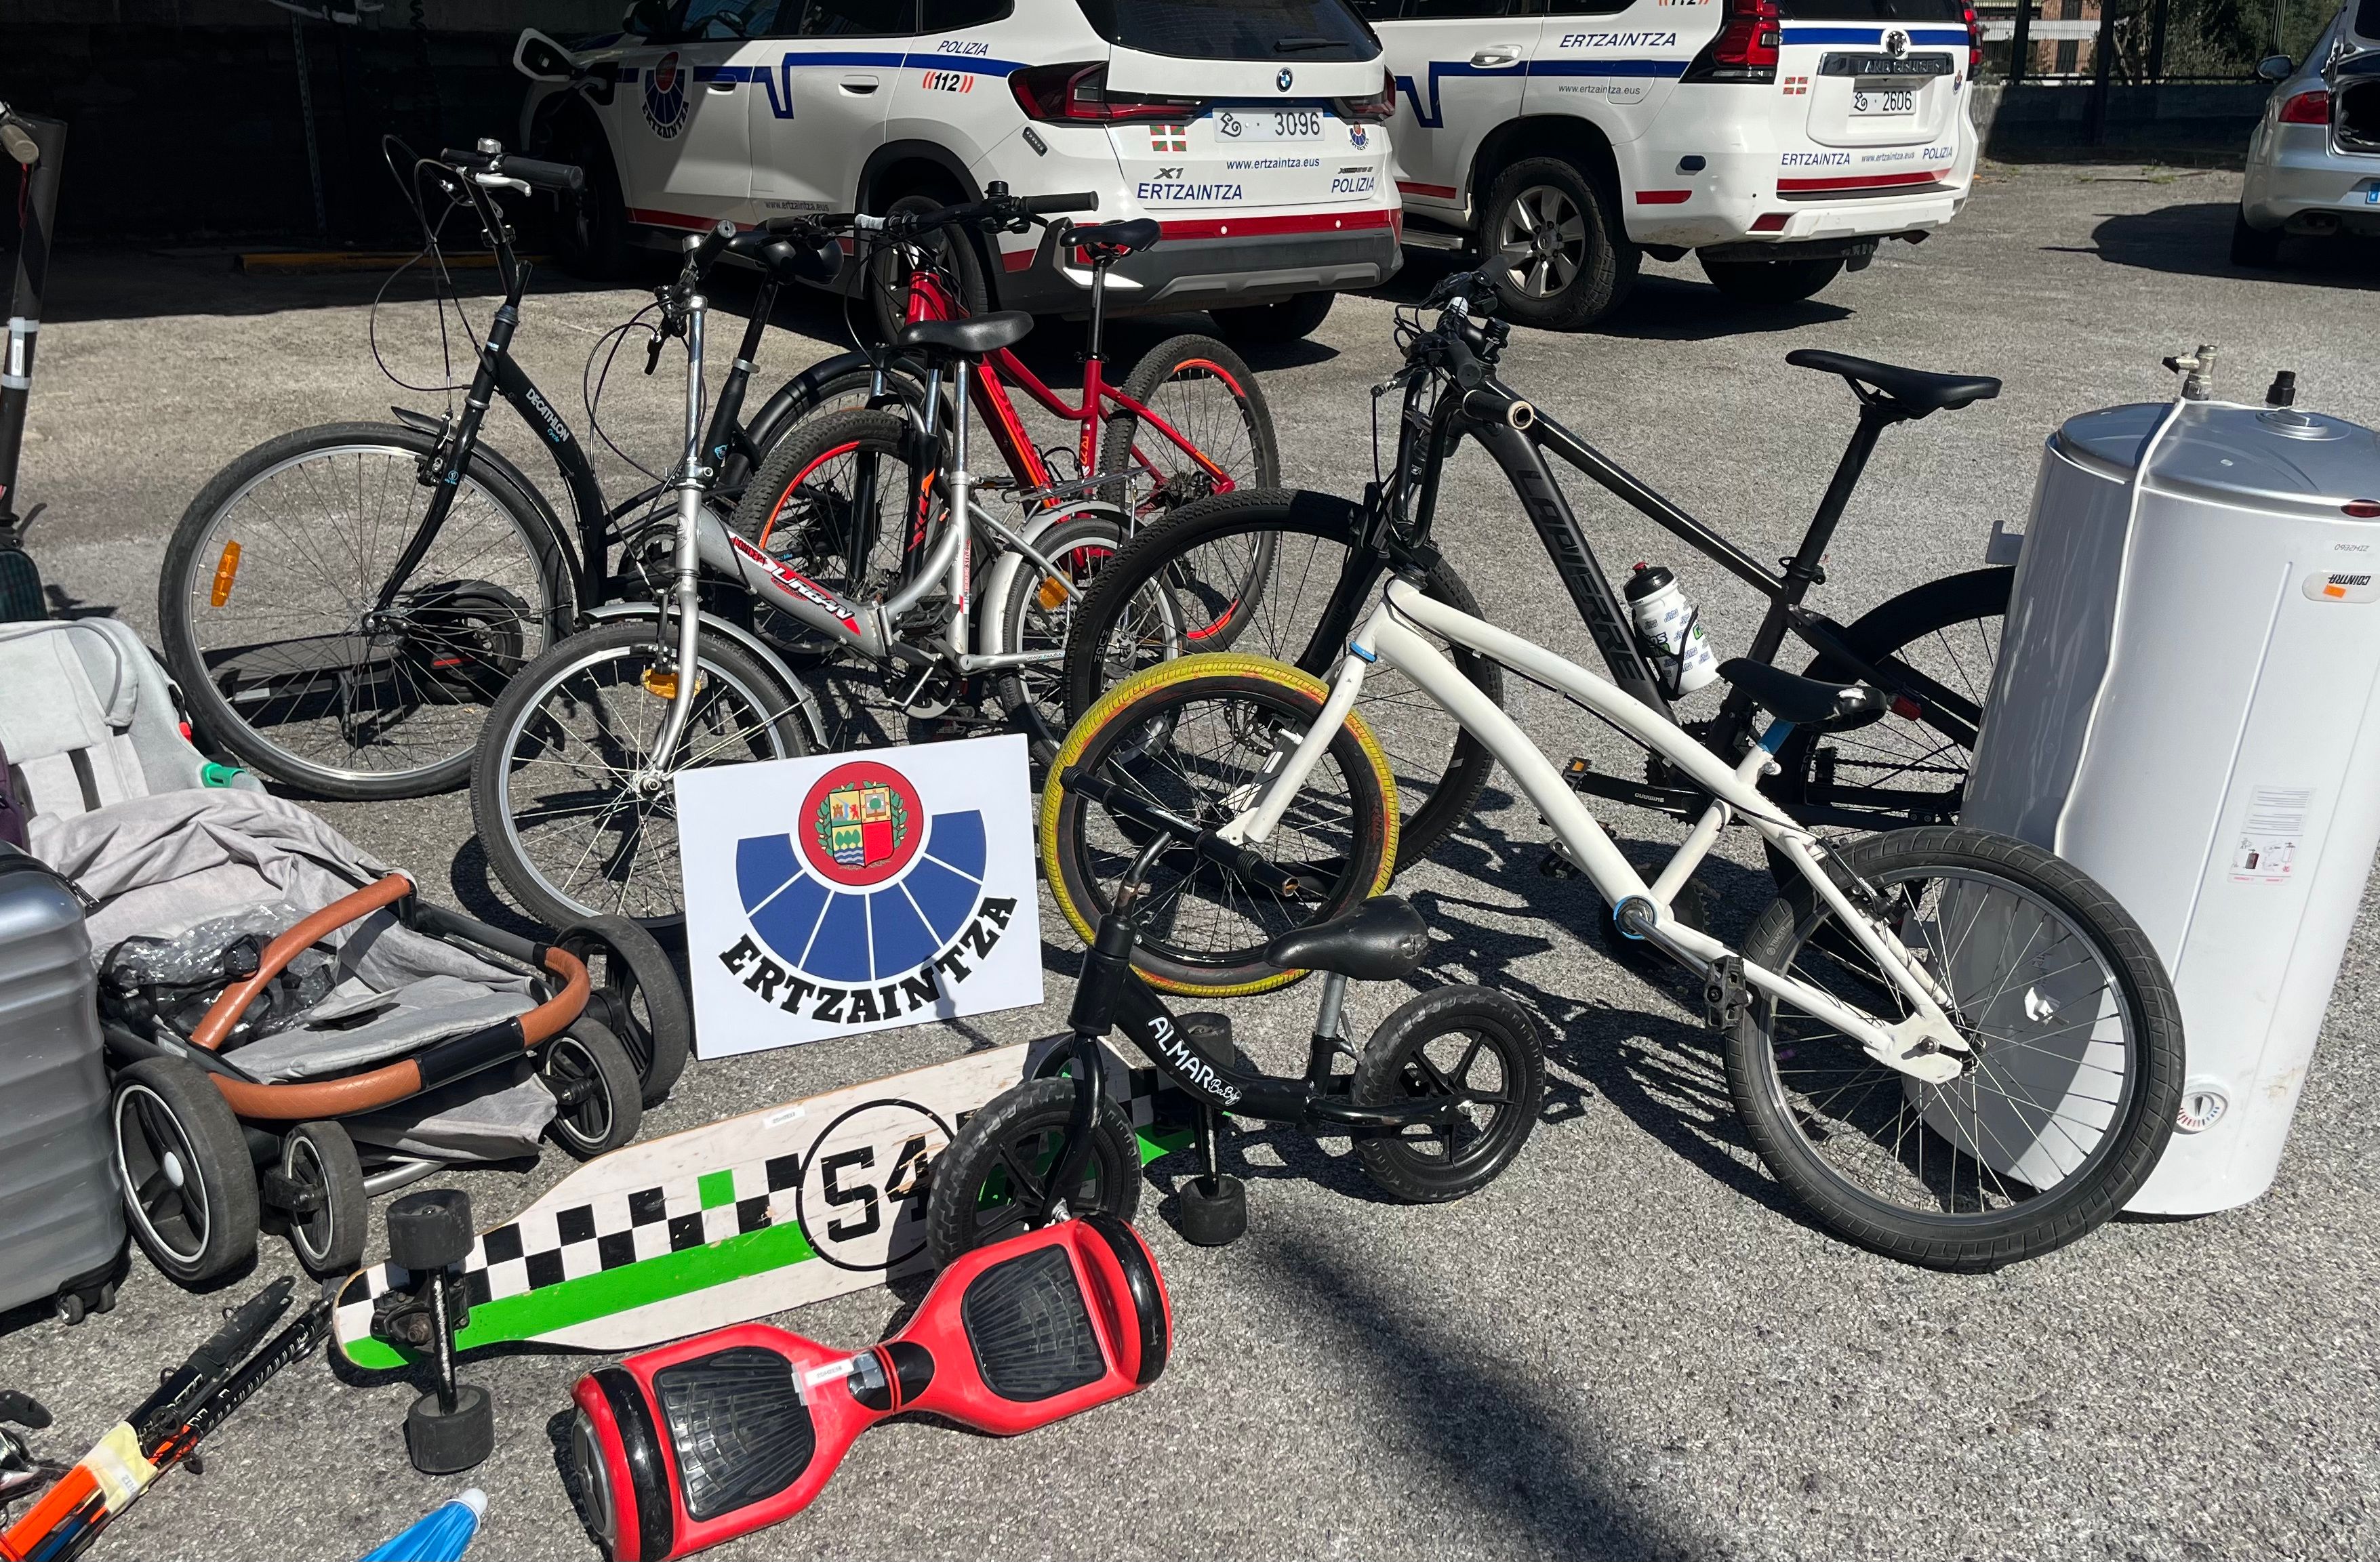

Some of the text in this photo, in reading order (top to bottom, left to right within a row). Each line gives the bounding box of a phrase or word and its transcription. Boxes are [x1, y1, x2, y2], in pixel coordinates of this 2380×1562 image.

[936, 40, 989, 56] POLIZIA
[1558, 33, 1677, 48] ERTZAINTZA
[1857, 59, 1941, 73] LAND CRUISER
[1558, 84, 1641, 95] www.ertzaintza.eus
[1882, 90, 1912, 111] 2606
[641, 100, 690, 139] ERTZAINTZA
[1274, 111, 1321, 136] 3096
[1781, 152, 1851, 165] ERTZAINTZA
[1861, 151, 1915, 163] www.ertzaintza.eus
[1922, 146, 1953, 160] POLIZIA
[1226, 157, 1320, 170] www.ertzaintza.eus
[1153, 167, 1184, 180] X1
[1137, 182, 1243, 201] ERTZAINTZA
[1331, 176, 1375, 194] POLIZIA
[765, 200, 830, 212] www.ertzaintza.eus
[525, 388, 570, 443] DECATHLON
[546, 428, 560, 444] Cycle
[1516, 470, 1647, 681] LAPIERRE
[2327, 573, 2371, 586] COINTRA
[771, 566, 855, 621] URBAN
[1093, 629, 1111, 663] EDGE
[1771, 925, 1788, 948] TRACER
[718, 896, 1018, 1025] ERTZAINTZA
[1148, 1016, 1214, 1089] ALMAR
[820, 1134, 932, 1244] 54
